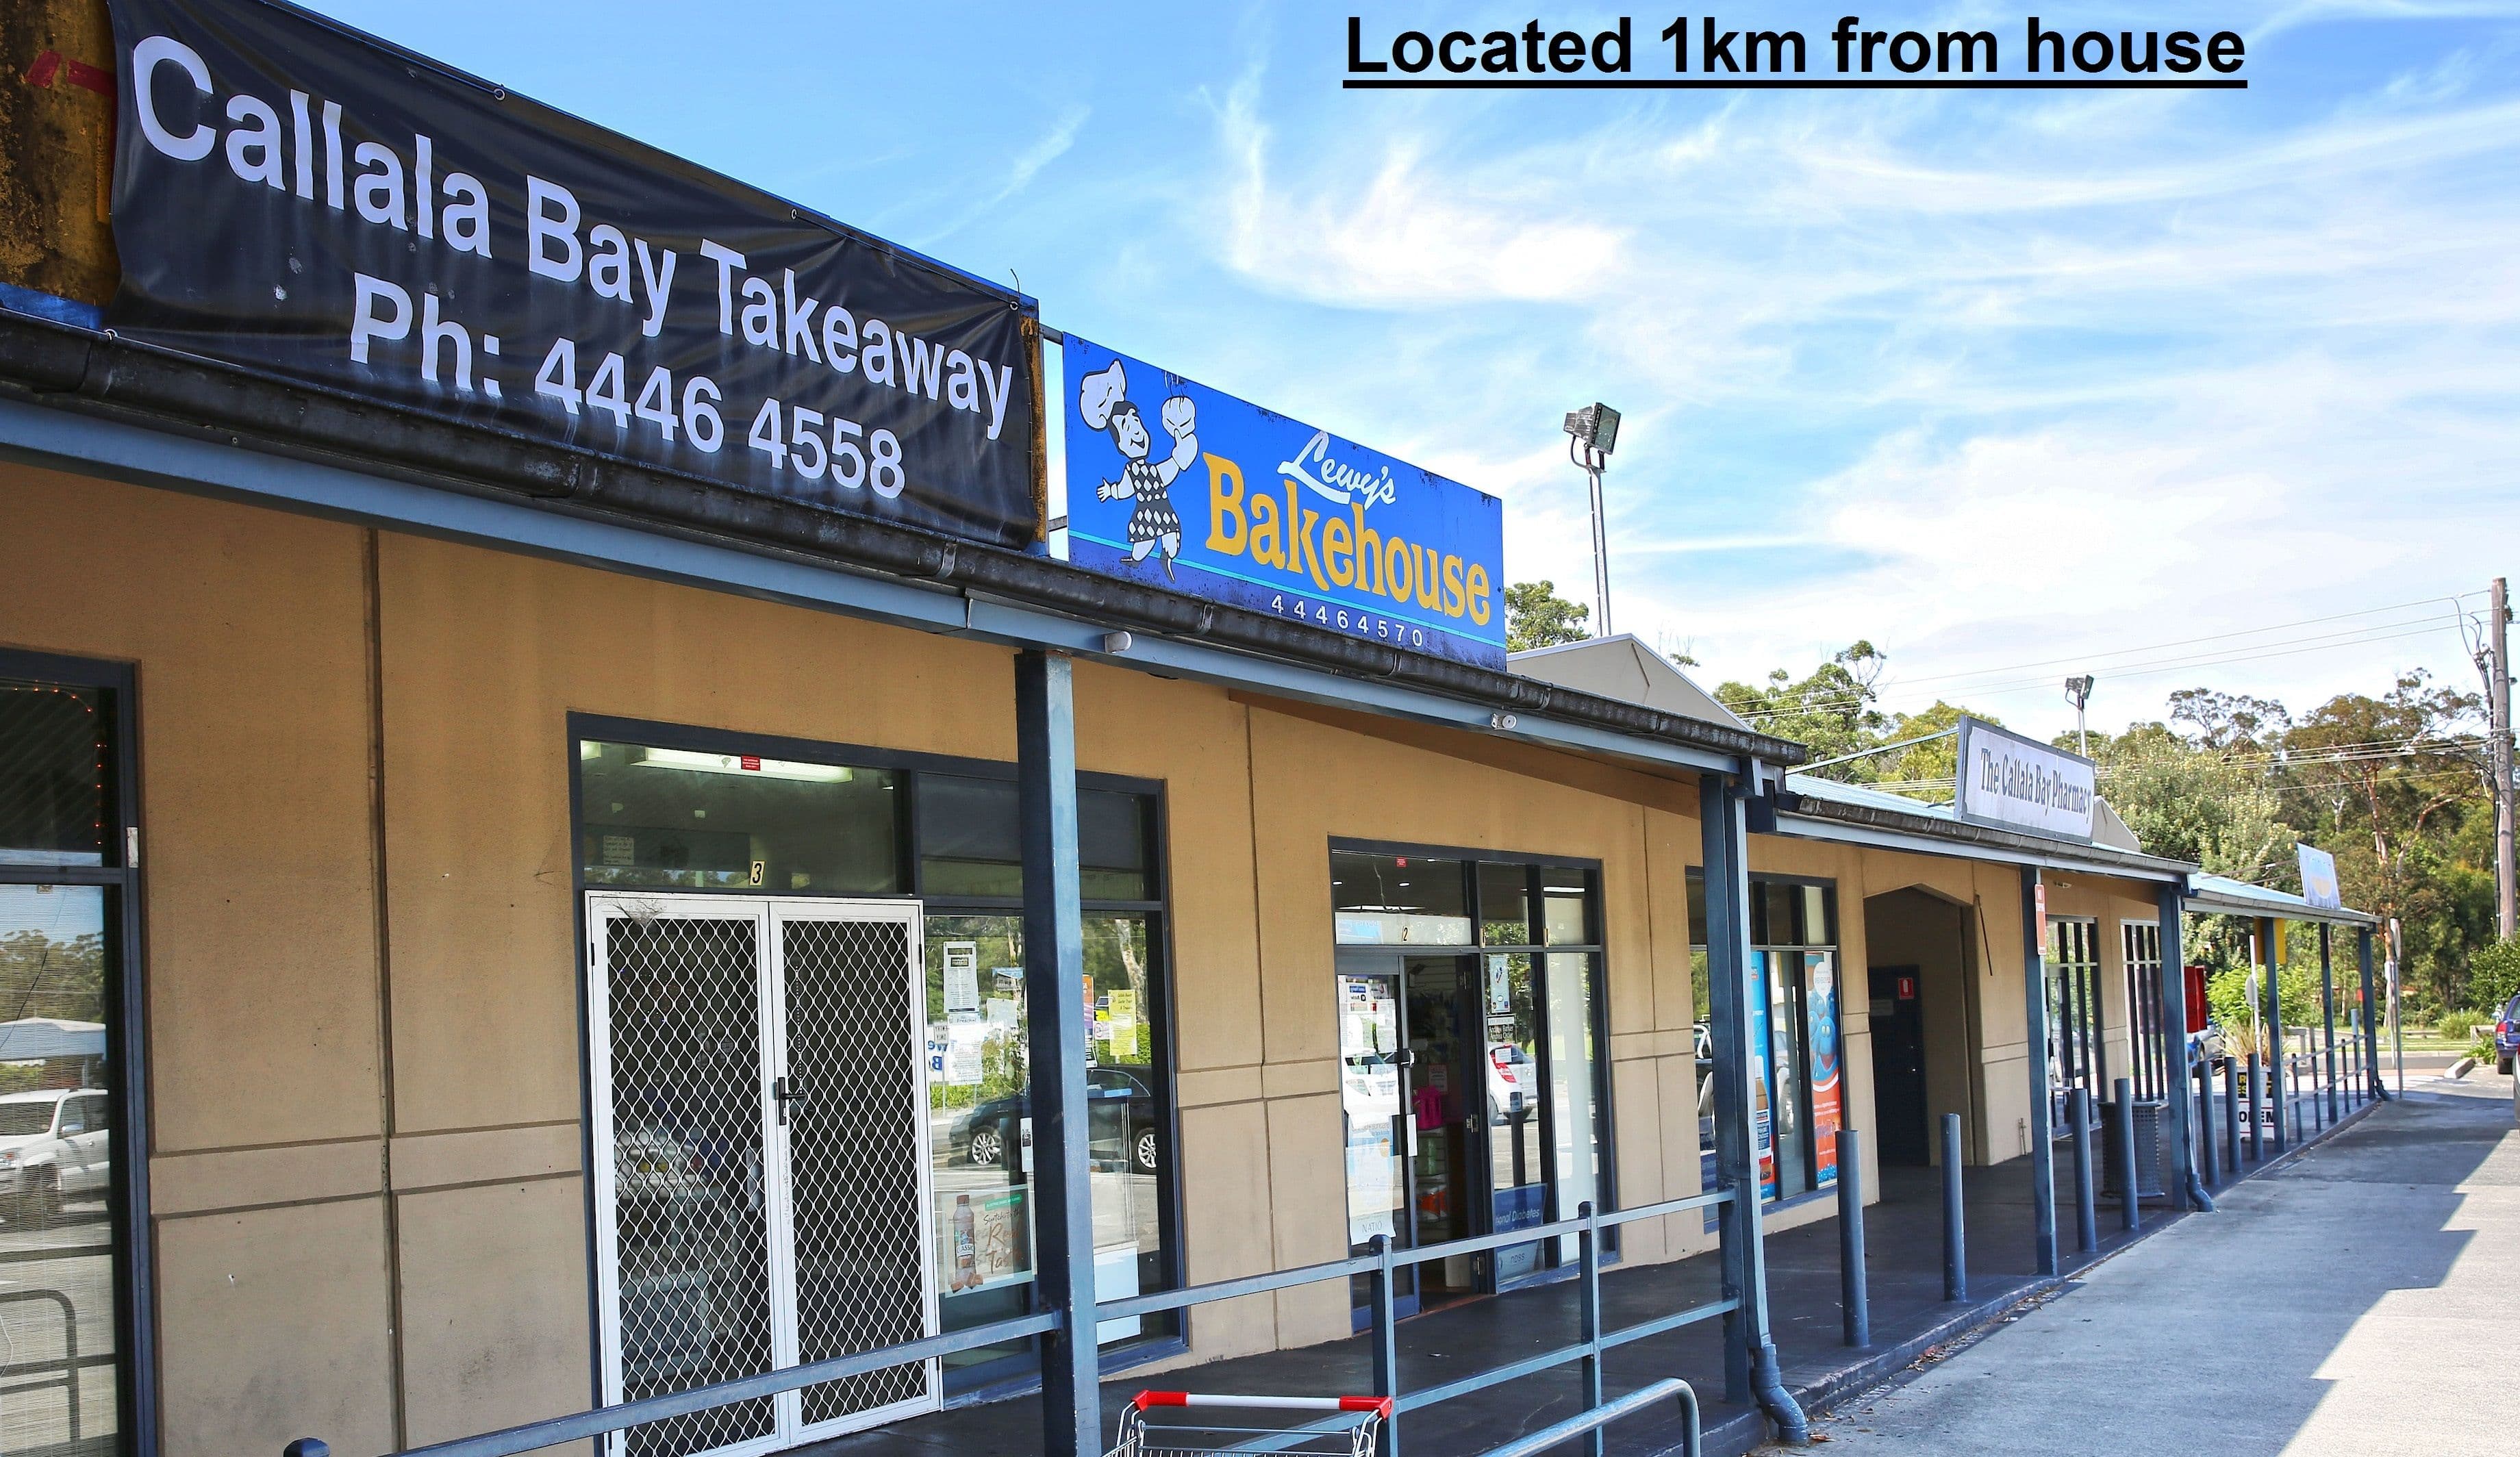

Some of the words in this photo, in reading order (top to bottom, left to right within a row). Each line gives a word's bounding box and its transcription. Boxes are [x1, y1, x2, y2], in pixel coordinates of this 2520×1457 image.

[133, 36, 492, 259] Callala
[527, 175, 676, 338] Bay
[700, 238, 1013, 440] Takeaway
[350, 272, 502, 397] Ph:
[534, 337, 724, 453] 4446
[748, 397, 906, 499] 4558
[1277, 431, 1396, 510] Lewy's
[1202, 451, 1491, 626] Bakehouse
[1271, 594, 1424, 647] 44464570
[1981, 748, 2000, 795] The
[2002, 753, 2033, 802] Callala
[2034, 763, 2052, 816] Bay
[2052, 770, 2091, 824] Pharmacy
[752, 862, 762, 883] 3
[1403, 927, 1408, 941] 2
[2239, 1111, 2273, 1123] OEN
[1511, 1207, 1540, 1221] Diabetes
